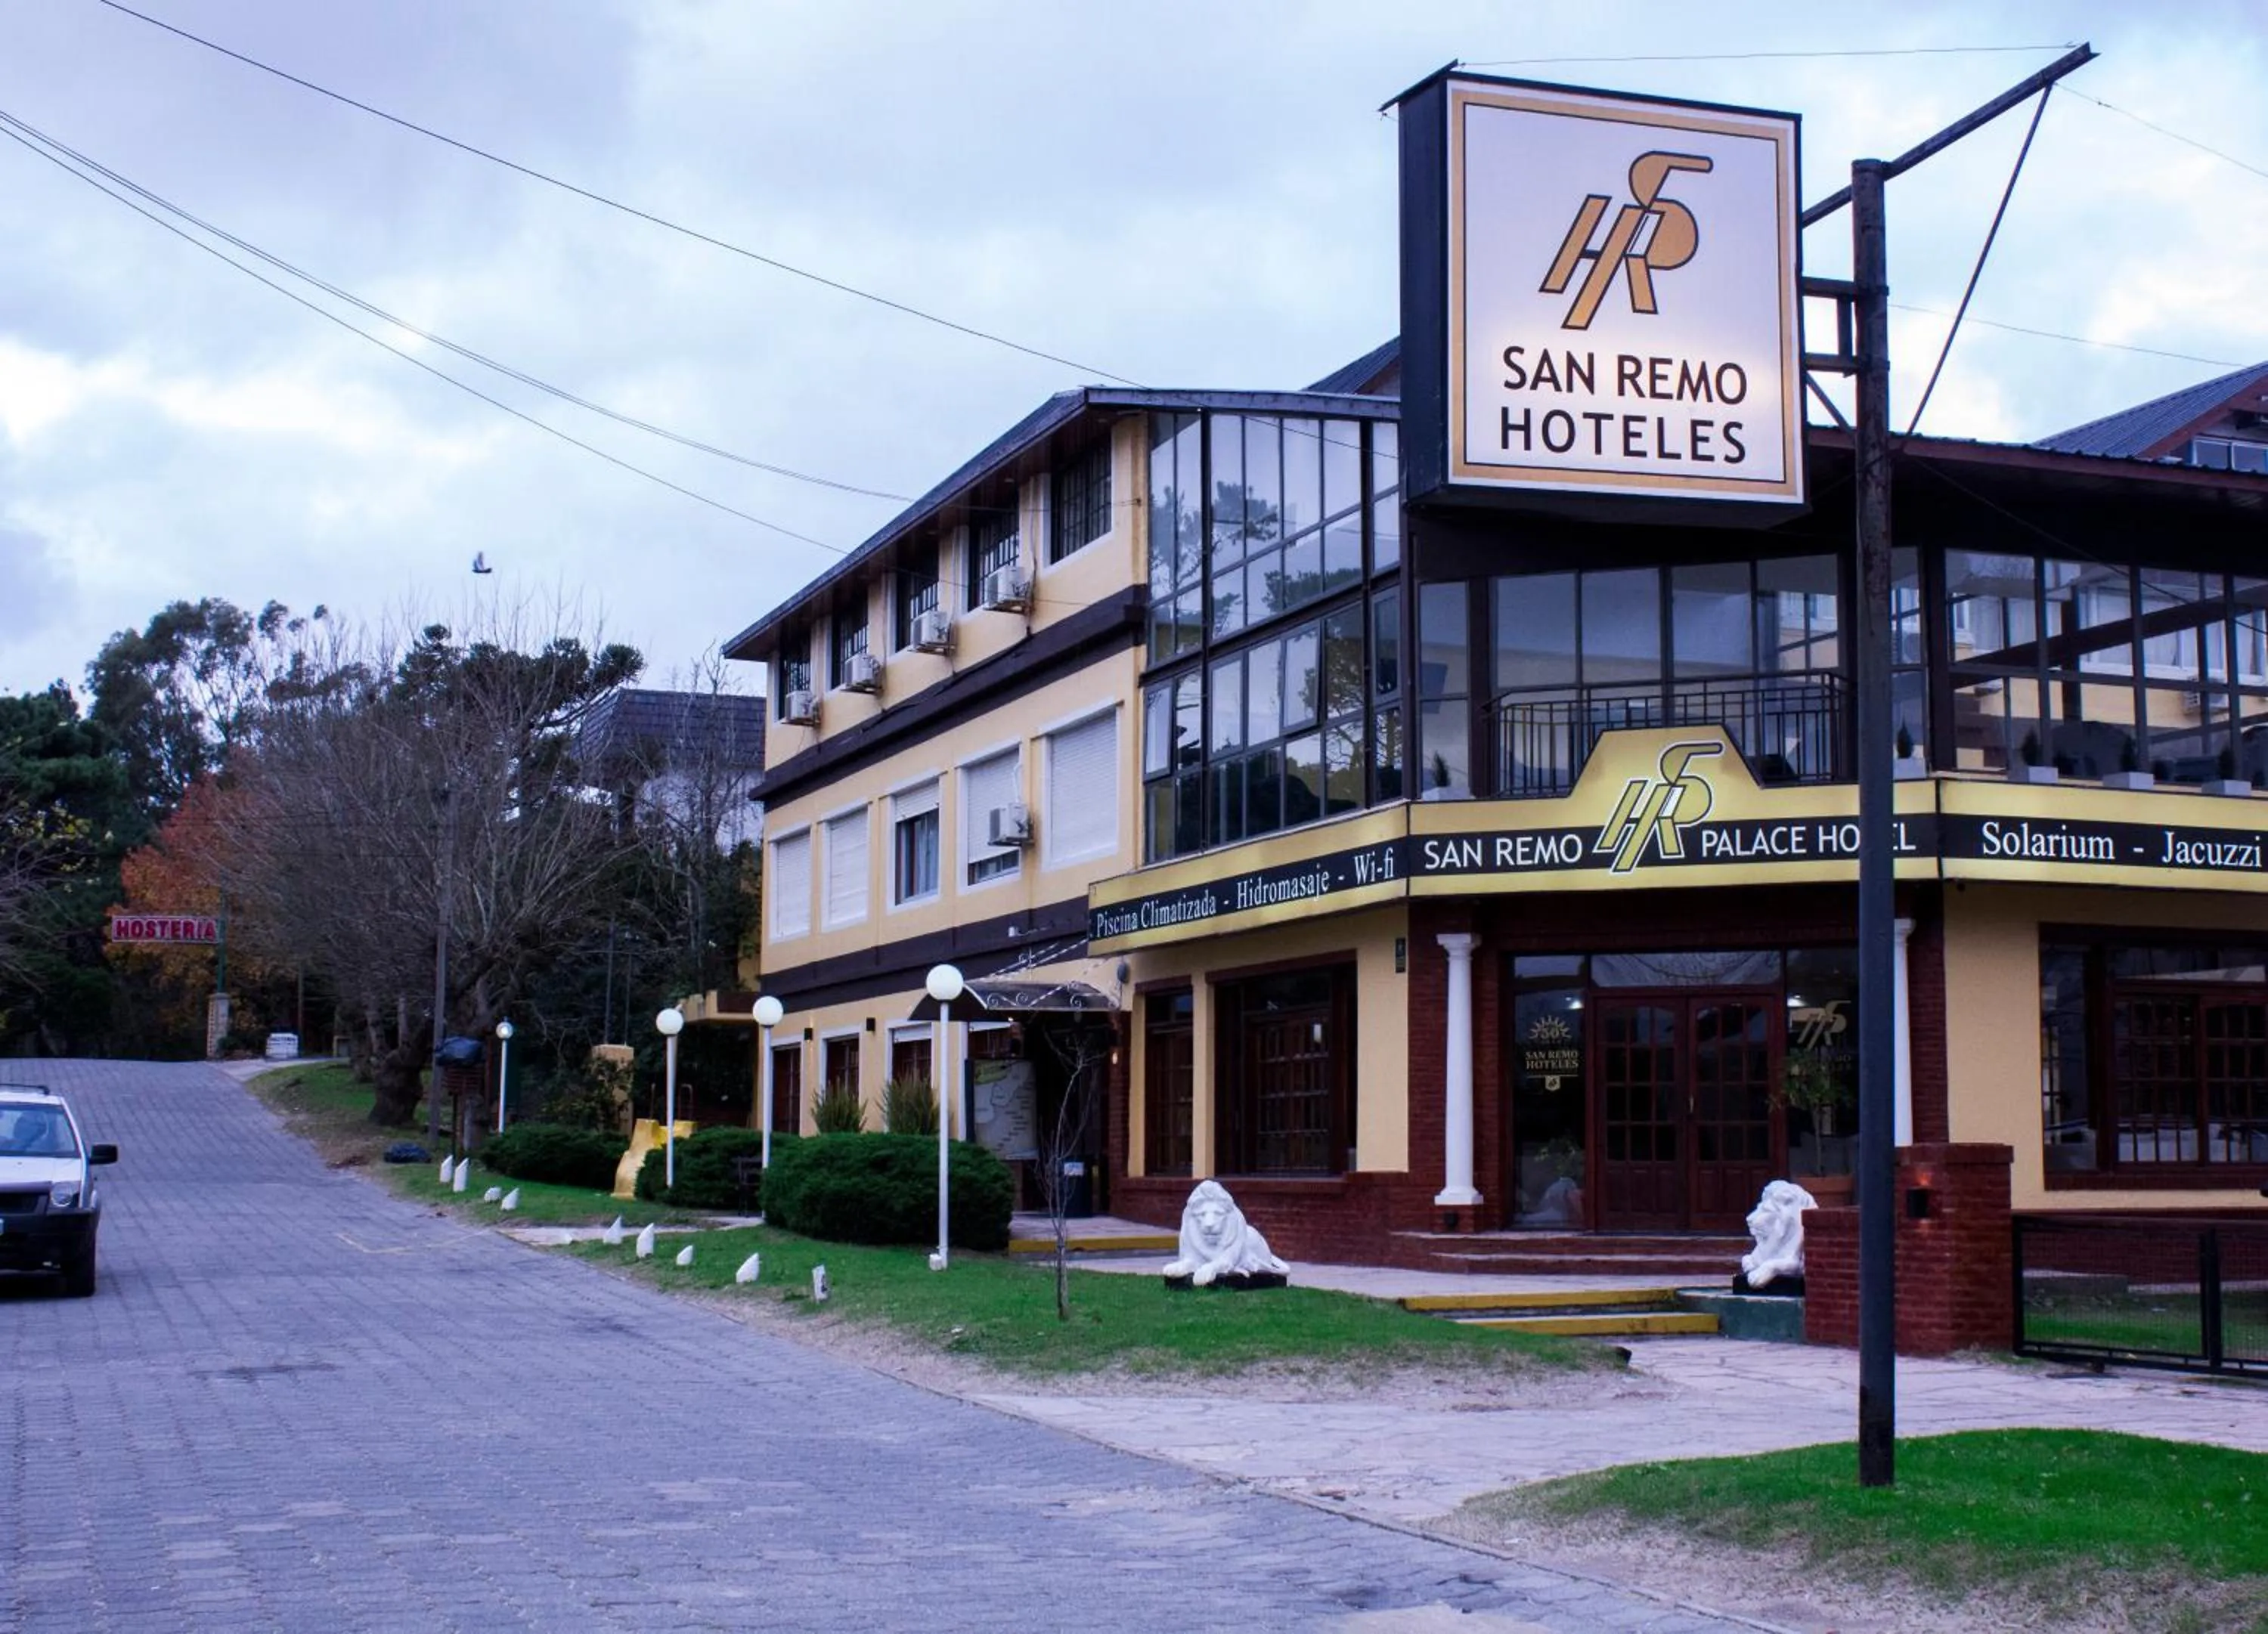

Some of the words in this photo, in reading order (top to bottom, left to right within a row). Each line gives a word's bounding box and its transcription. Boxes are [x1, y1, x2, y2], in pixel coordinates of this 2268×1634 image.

[1503, 345, 1594, 395] SAN
[1617, 354, 1747, 405] REMO
[1501, 406, 1746, 464] HOTELES
[1424, 839, 1483, 869] SAN
[1495, 834, 1583, 867] REMO
[1702, 826, 1807, 858] PALACE
[1818, 822, 1916, 853] HOL
[1981, 822, 2115, 859] Solarium
[2161, 831, 2262, 867] Jacuzzi
[1096, 908, 1138, 938] Piscina
[1140, 889, 1216, 928] Climatizada
[1236, 863, 1330, 909] Hidromasaje
[1353, 847, 1394, 885] Wi-fi
[116, 919, 216, 939] HOSTERIA
[1526, 1060, 1579, 1069] HOTELES
[1548, 1050, 1579, 1059] REMO
